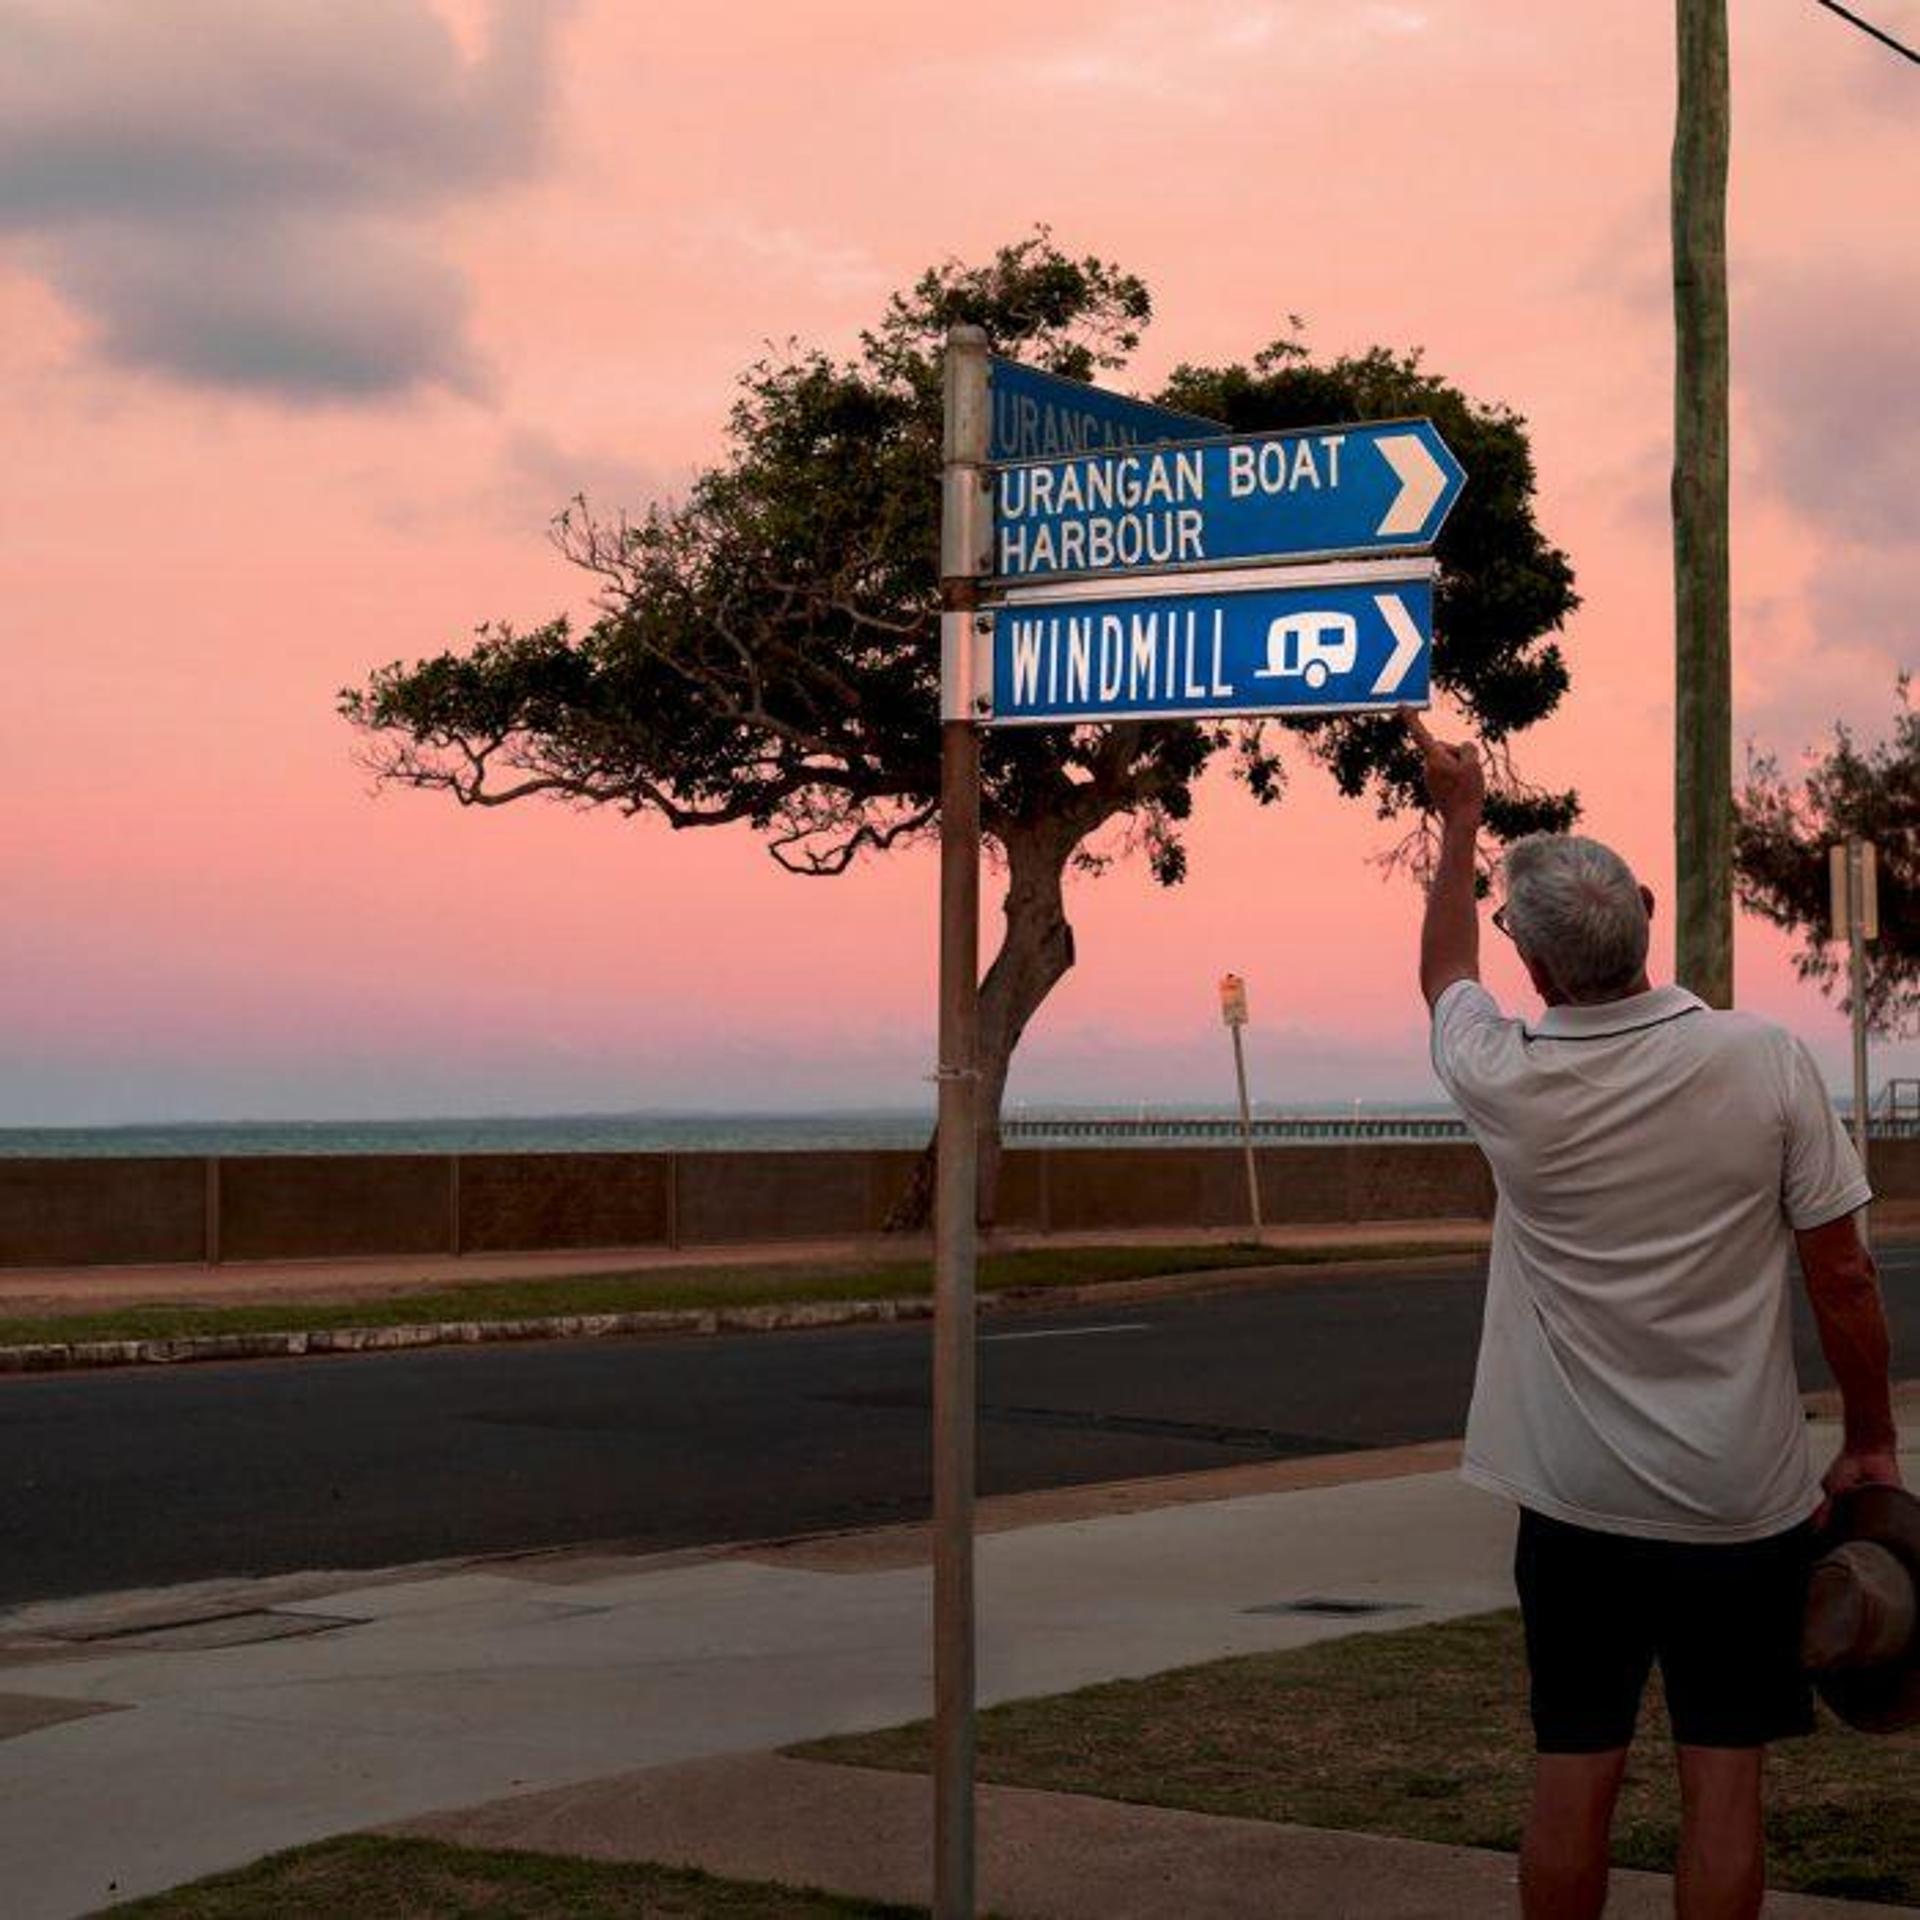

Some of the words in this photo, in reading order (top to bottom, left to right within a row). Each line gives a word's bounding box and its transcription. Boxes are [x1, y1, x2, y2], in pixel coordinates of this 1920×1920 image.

[1002, 452, 1203, 519] URANGAN
[1230, 437, 1345, 497] BOAT
[1002, 511, 1204, 575] HARBOUR
[1012, 610, 1233, 705] WINDMILL
